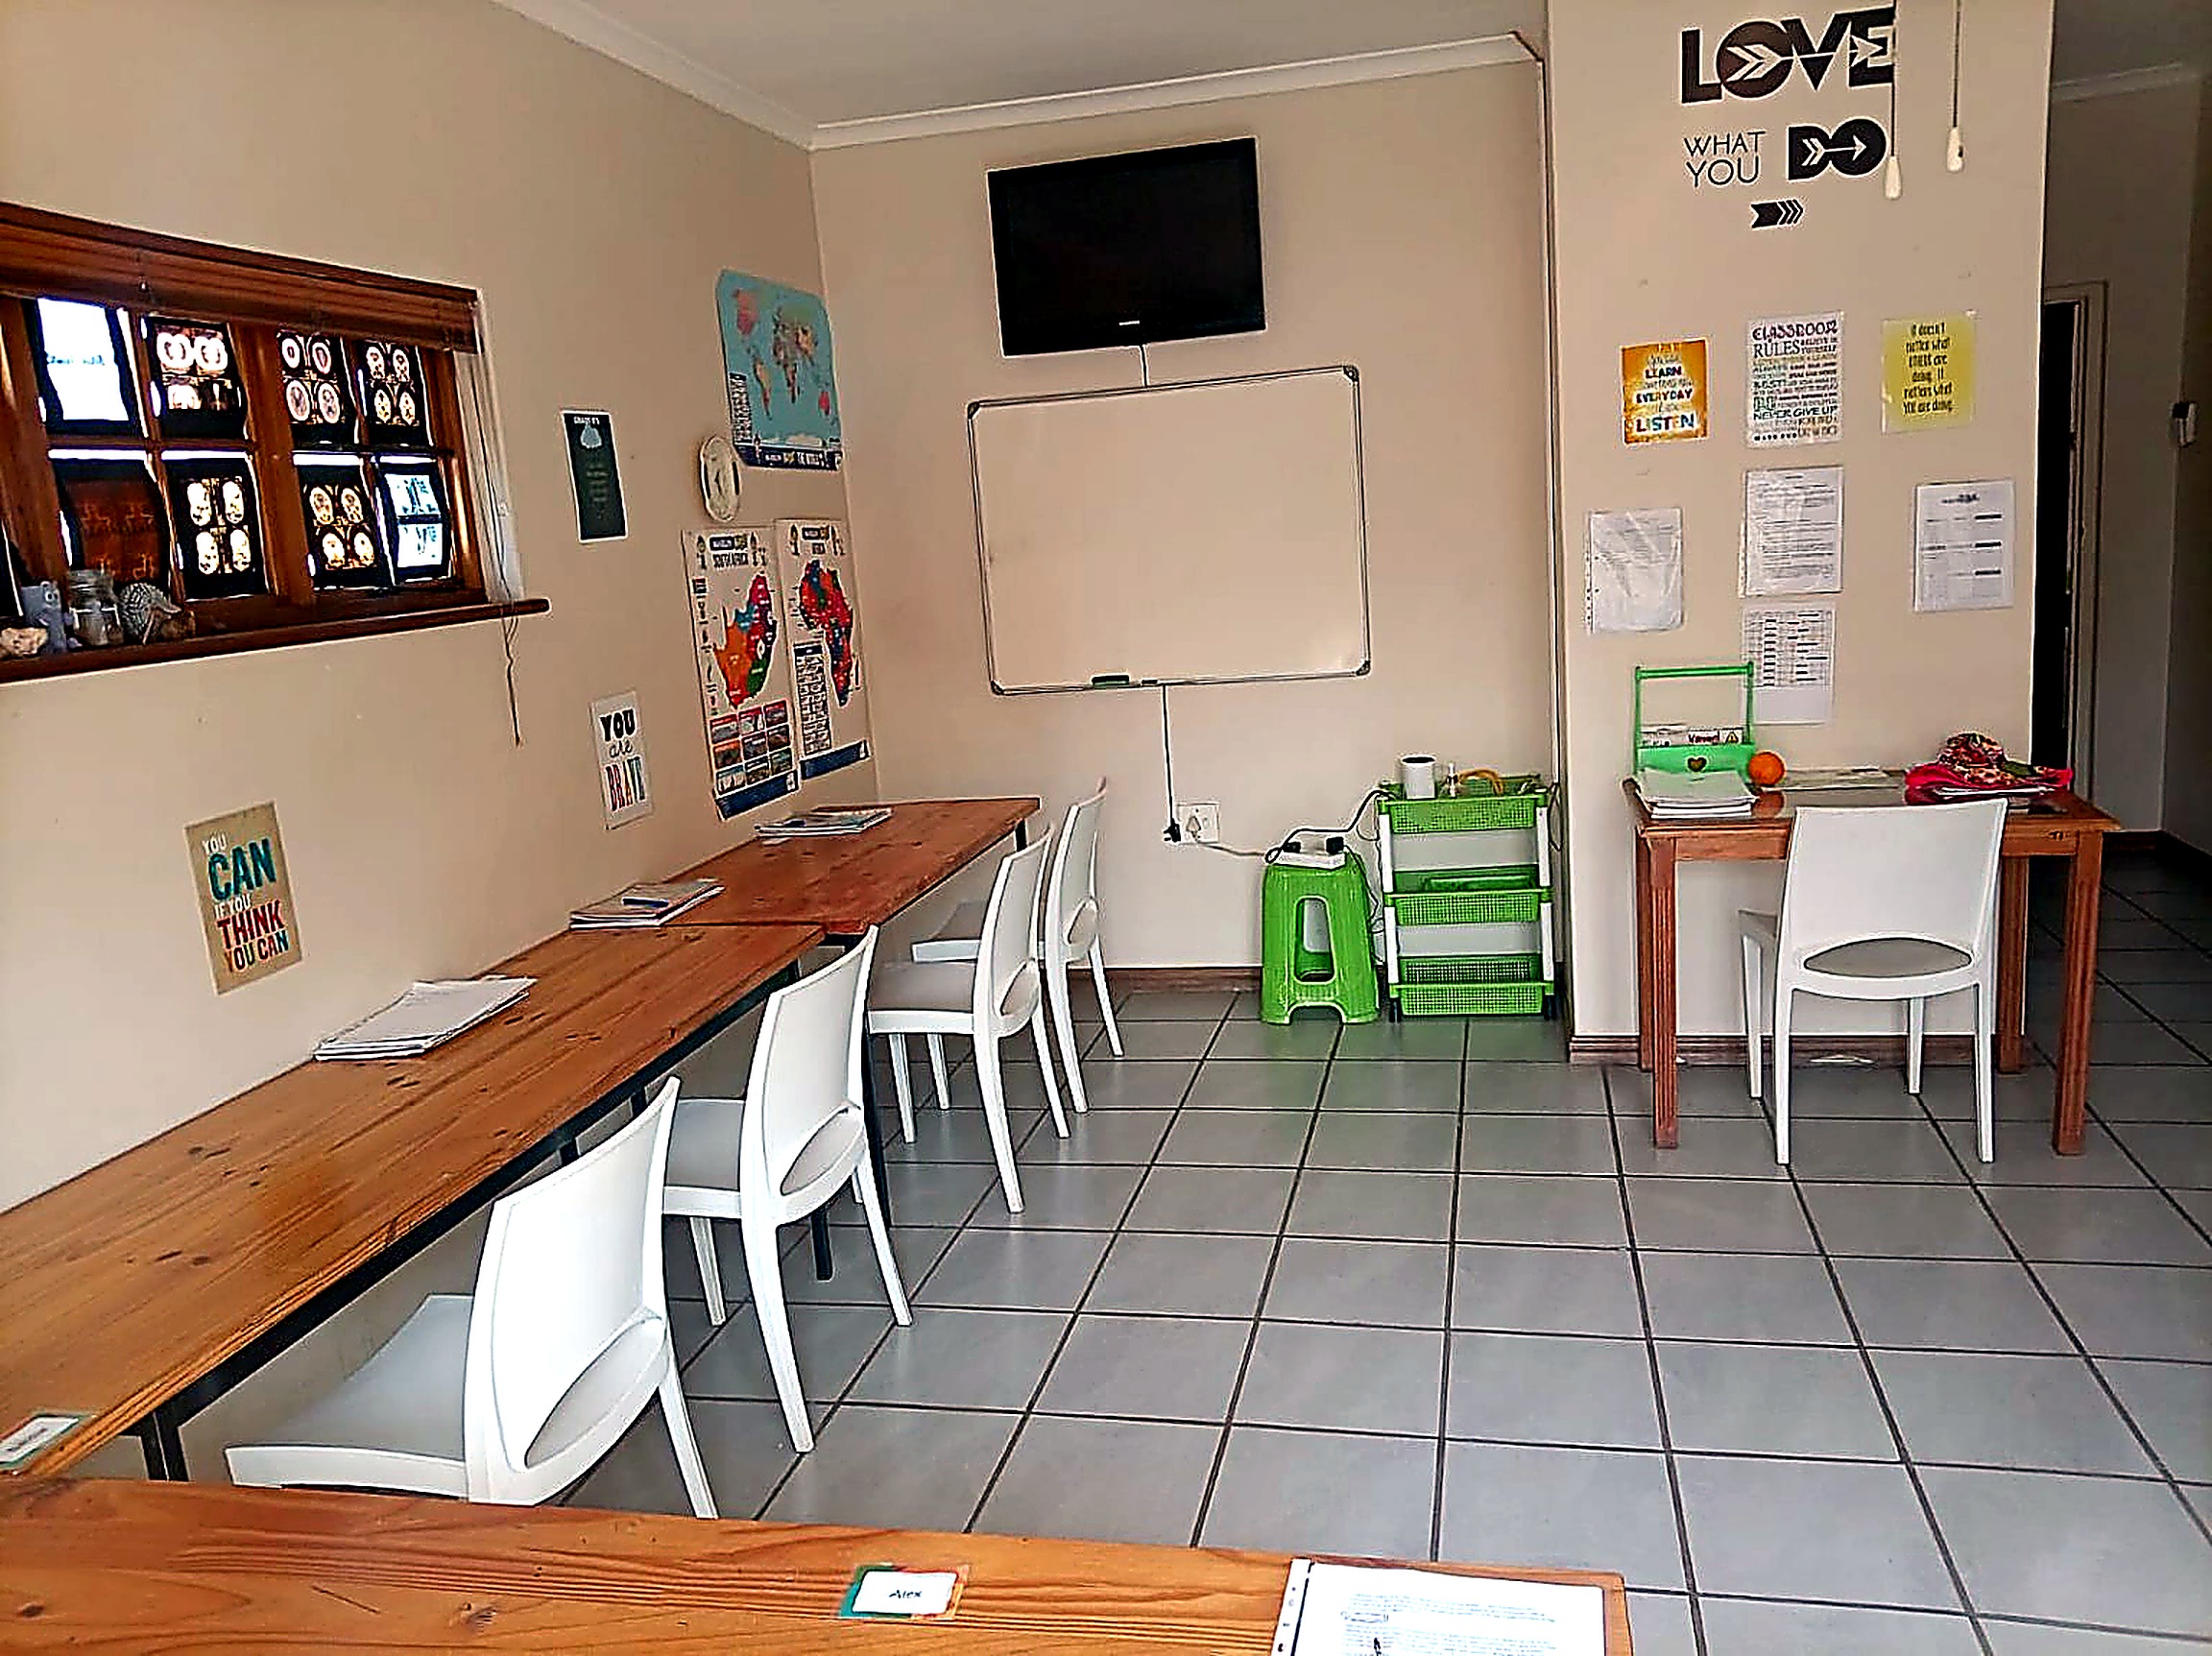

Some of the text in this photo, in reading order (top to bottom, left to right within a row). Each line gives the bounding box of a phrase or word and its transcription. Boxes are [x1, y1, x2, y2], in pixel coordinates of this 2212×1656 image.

[1681, 7, 1896, 104] LOVE
[1684, 118, 1887, 180] WHAT DO
[1686, 156, 1759, 188] YOU
[1753, 339, 1801, 358] RULES
[1645, 366, 1682, 379] LEARN
[1636, 388, 1694, 404] EVERYDAY
[1636, 414, 1695, 433] LISTEN
[1792, 406, 1821, 418] GIVE
[1821, 404, 1839, 415] UP
[600, 708, 636, 742] YOU
[201, 833, 228, 855] YOU
[208, 838, 277, 901] CAN
[214, 894, 252, 920] IF YOU
[217, 899, 285, 949] THINK
[224, 929, 289, 972] YOU CAN
